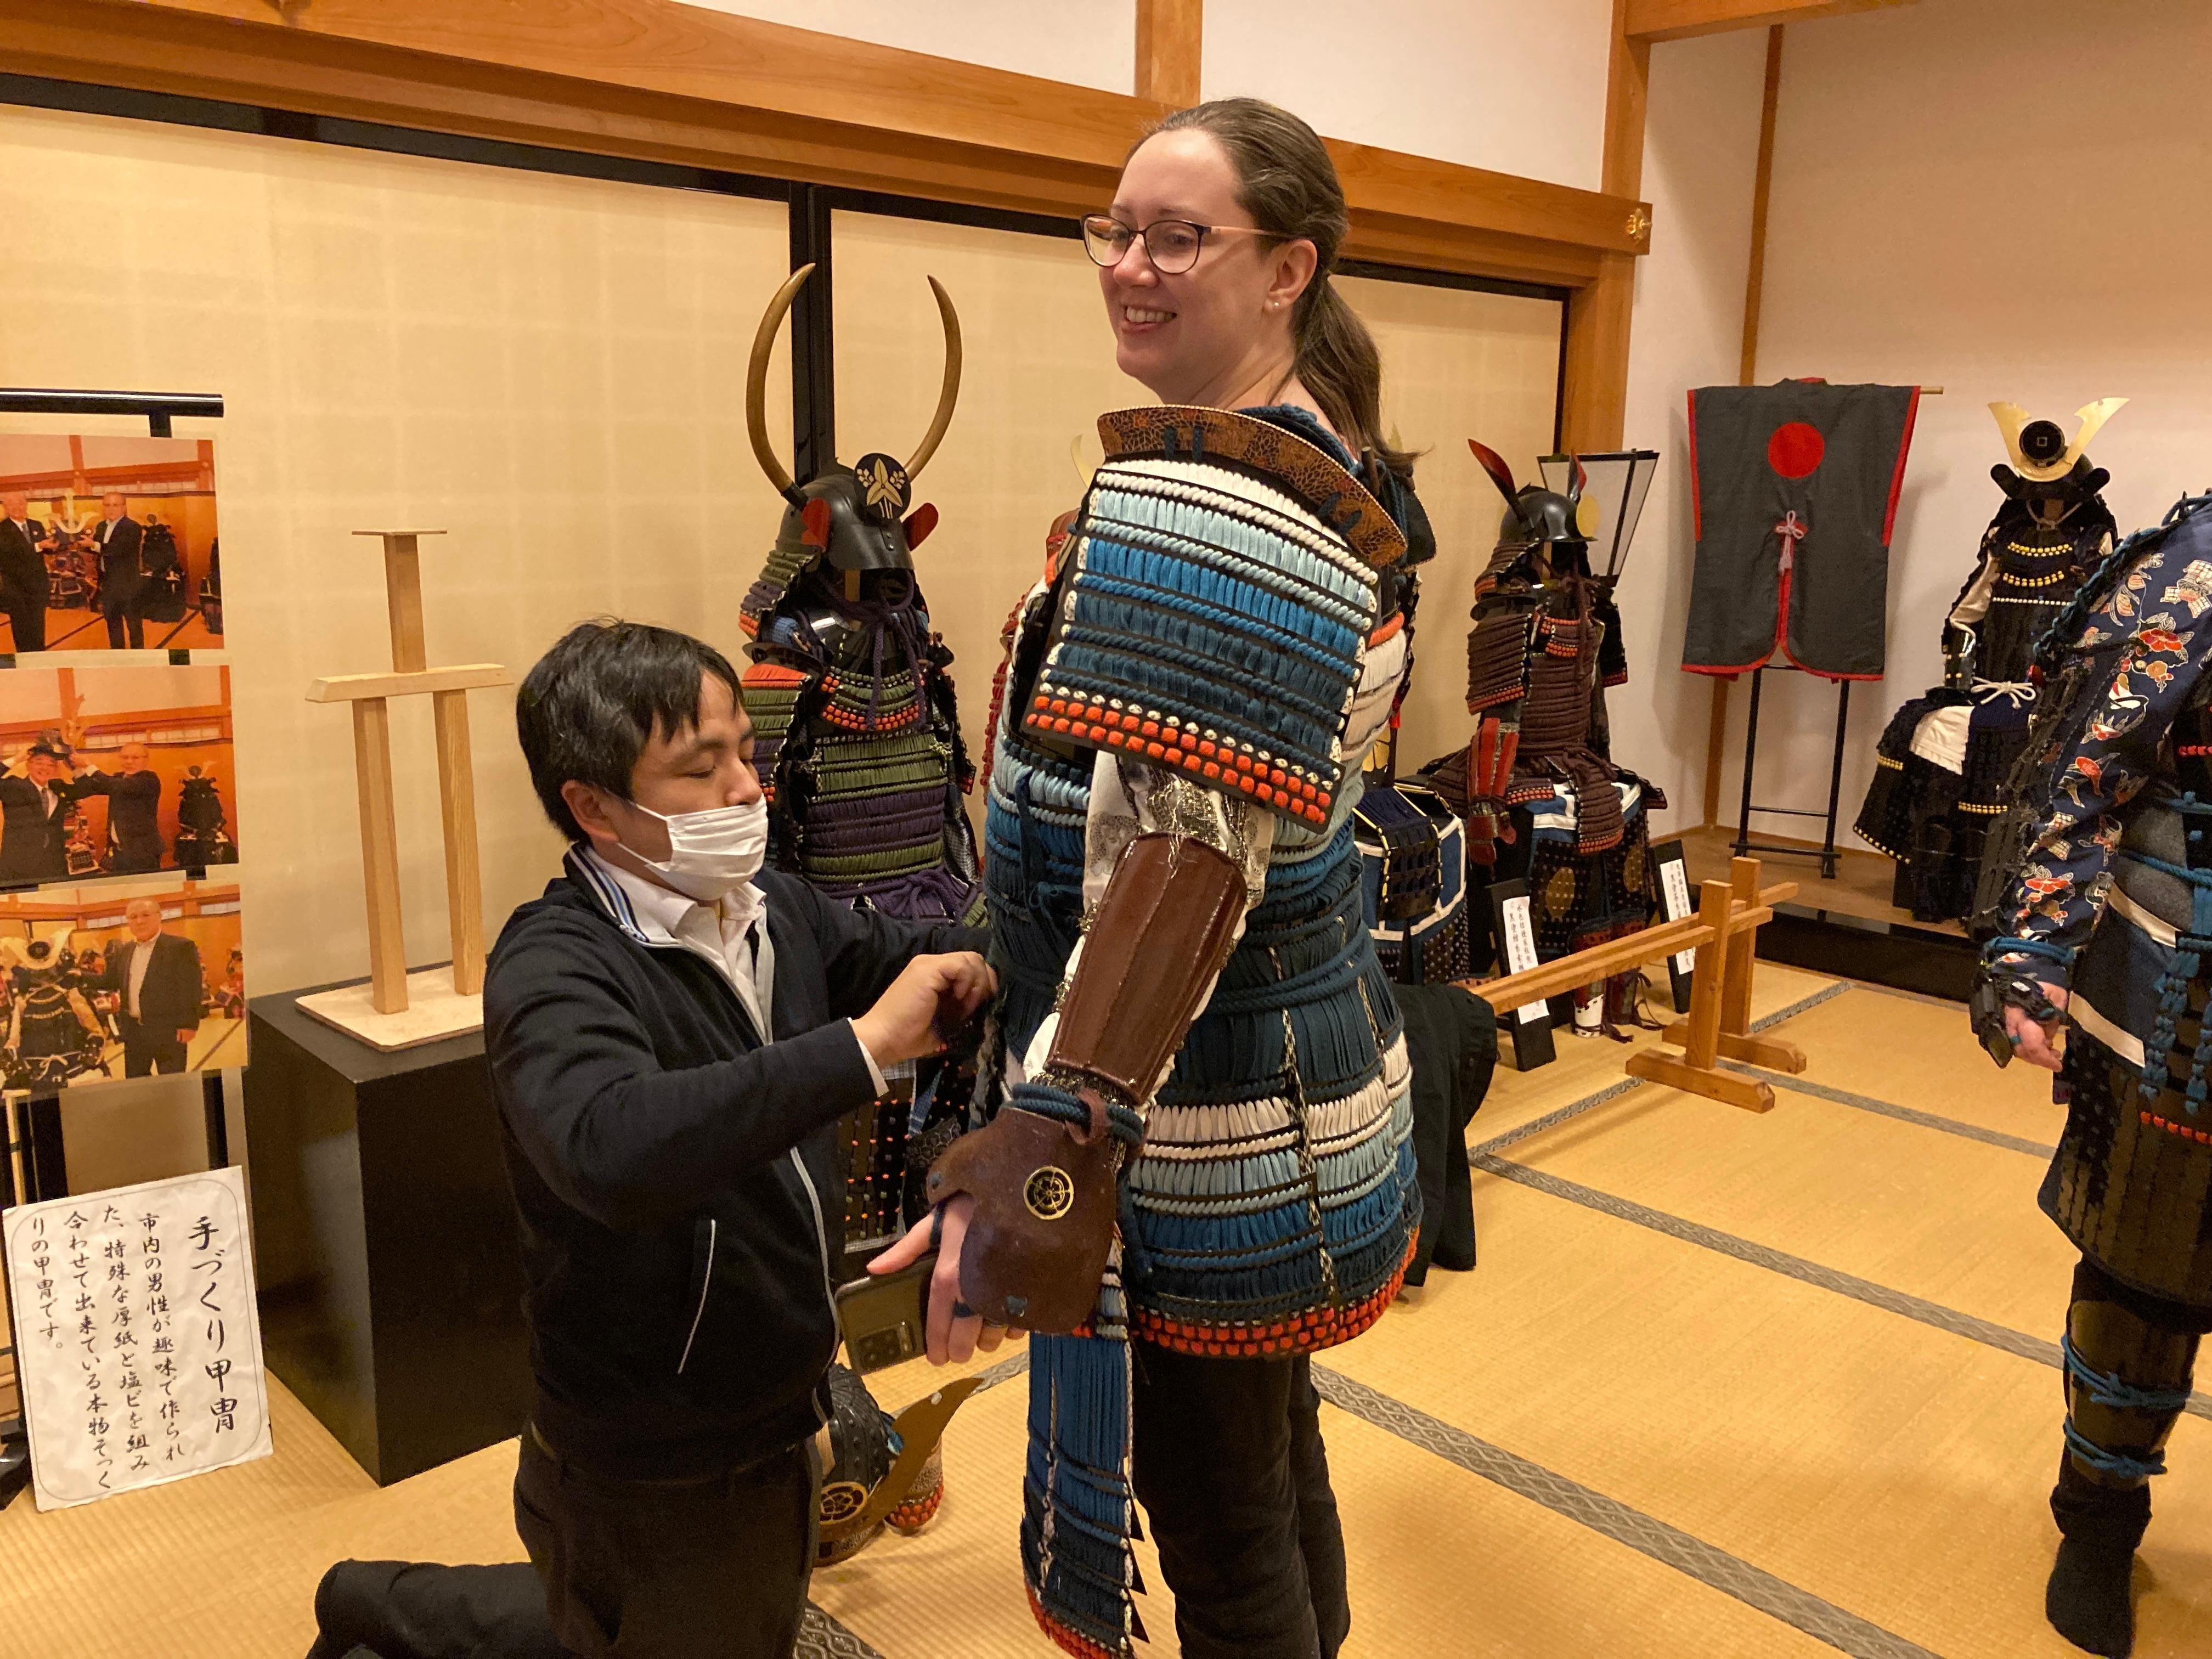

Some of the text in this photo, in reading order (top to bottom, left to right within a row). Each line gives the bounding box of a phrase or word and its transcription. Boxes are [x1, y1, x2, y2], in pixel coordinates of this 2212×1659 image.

[32, 1217, 63, 1350] りの甲冑です。
[104, 1205, 150, 1470] た、特殊な厚紙と塩ビを組み
[139, 1212, 185, 1461] 市内の男性が趣味で作られ
[188, 1216, 238, 1434] 手づくり甲冑
